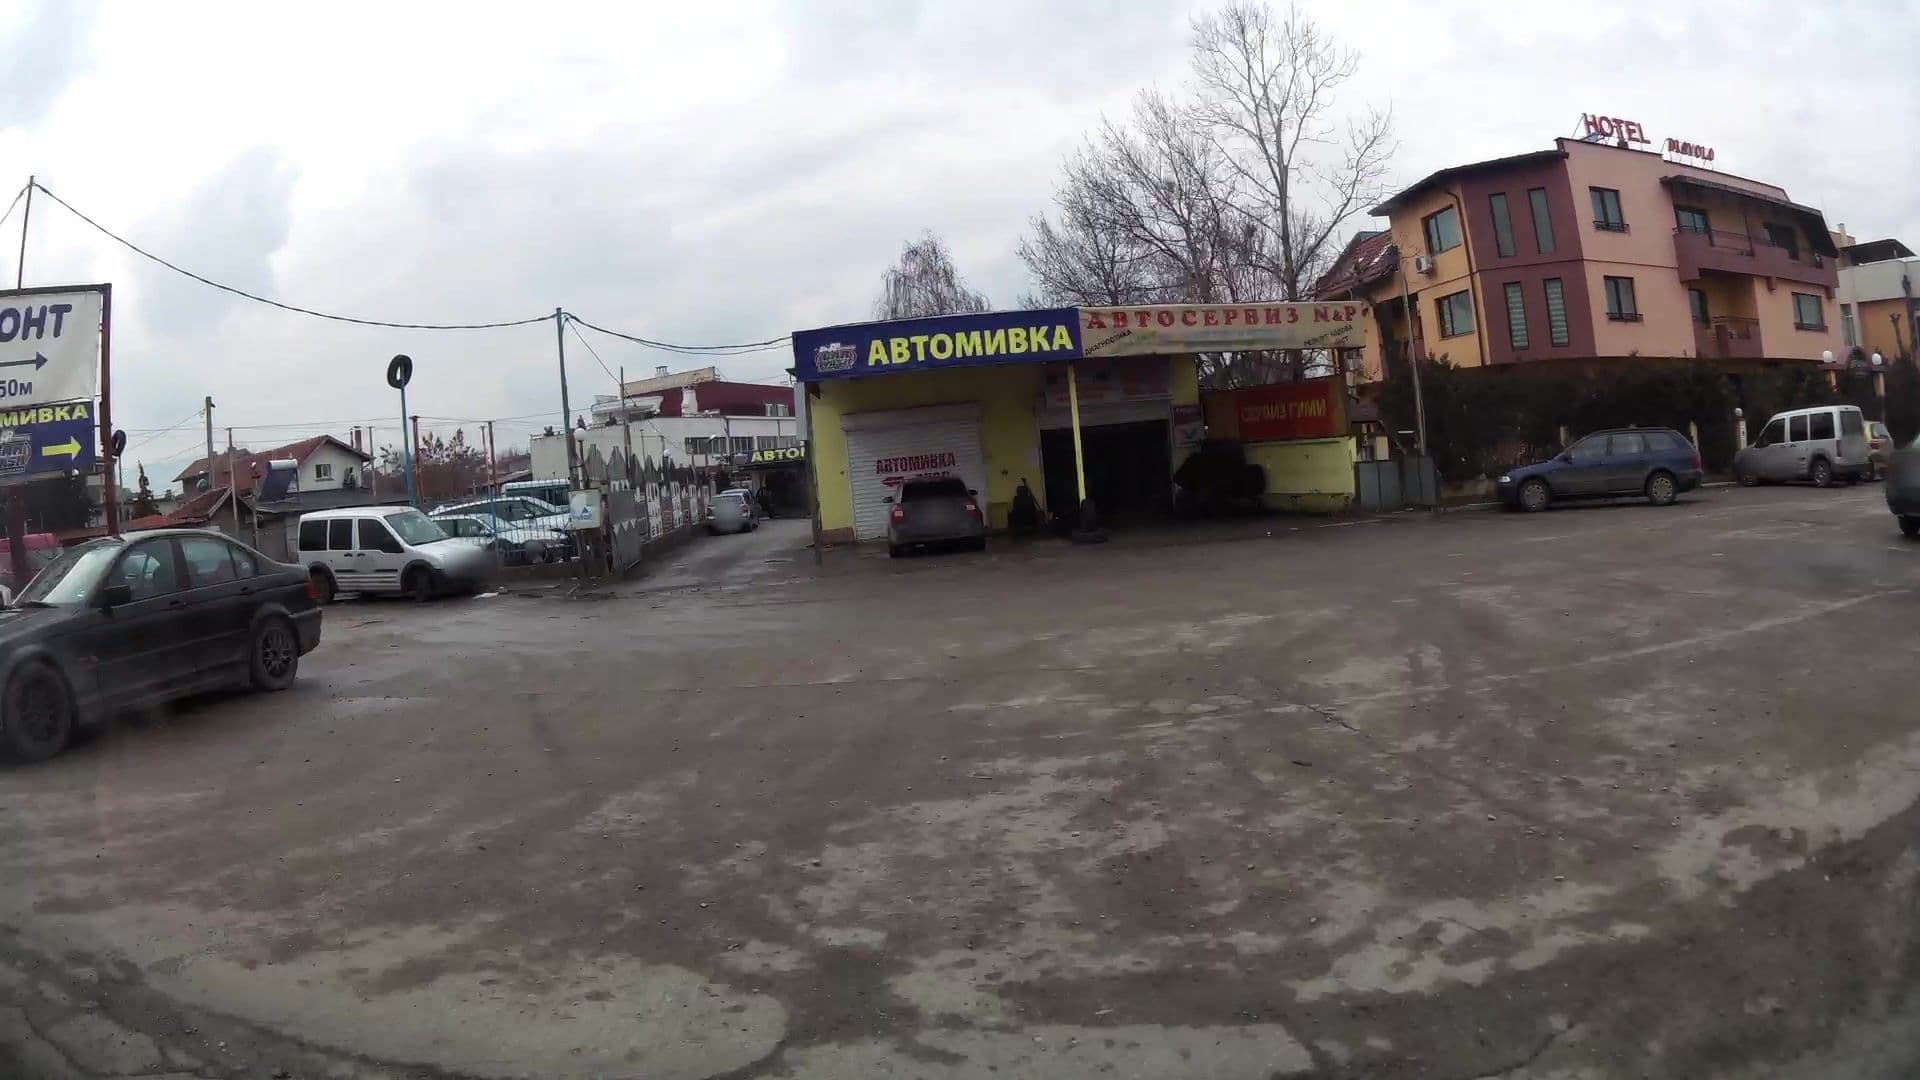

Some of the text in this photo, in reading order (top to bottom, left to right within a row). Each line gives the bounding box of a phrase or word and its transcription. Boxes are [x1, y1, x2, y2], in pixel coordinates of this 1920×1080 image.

[1583, 113, 1651, 145] HOTEL
[1086, 307, 1299, 330] АВТОСЕРВИЗ
[867, 324, 1074, 367] АВТОМИВКА
[1084, 328, 1133, 356] ДИАГНОСТИКА
[875, 452, 956, 475] АВТОМИВКА
